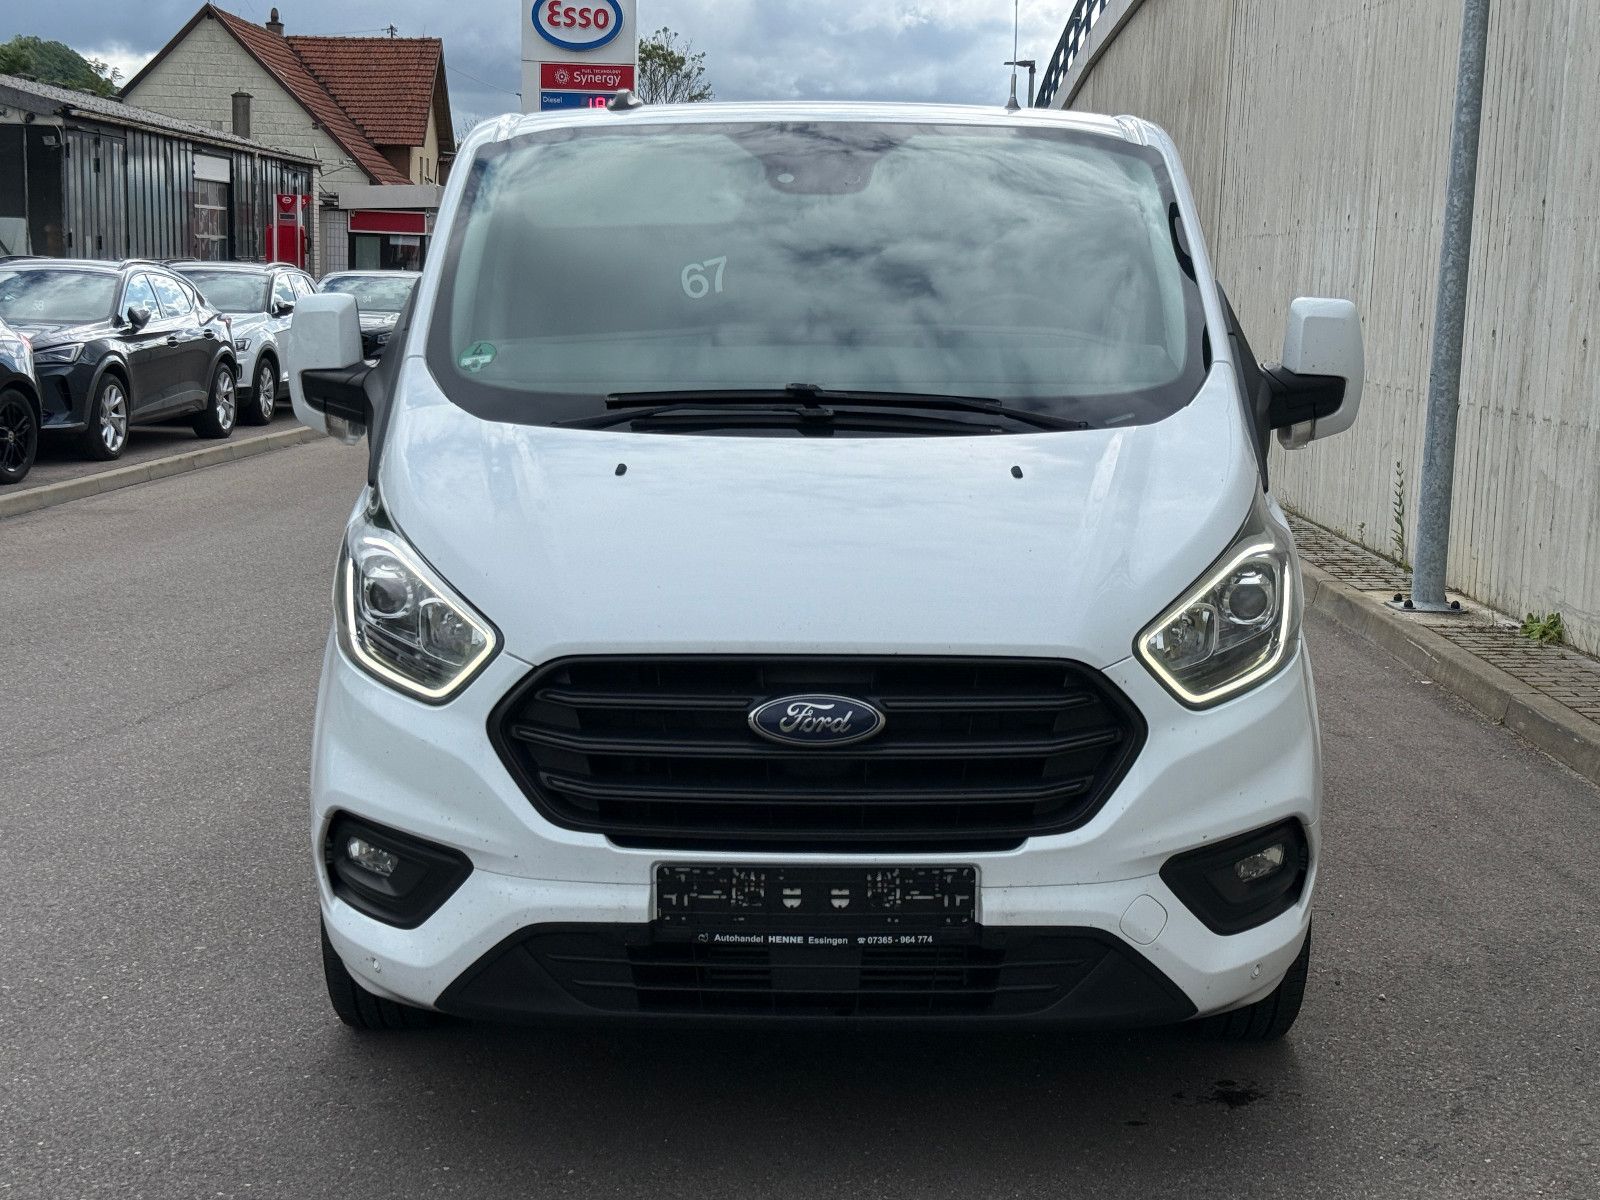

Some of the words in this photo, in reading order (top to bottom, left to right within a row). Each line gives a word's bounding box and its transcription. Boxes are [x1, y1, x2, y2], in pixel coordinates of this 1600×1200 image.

[573, 72, 621, 87] Synergy
[542, 96, 563, 104] Diesel
[681, 255, 727, 299] 67
[780, 702, 853, 733] Ford
[714, 933, 764, 943] Autohandel
[768, 935, 804, 944] HENNE
[808, 936, 848, 946] Essingen
[867, 936, 893, 944] 07365
[900, 935, 916, 944] 964
[917, 935, 933, 944] 774
